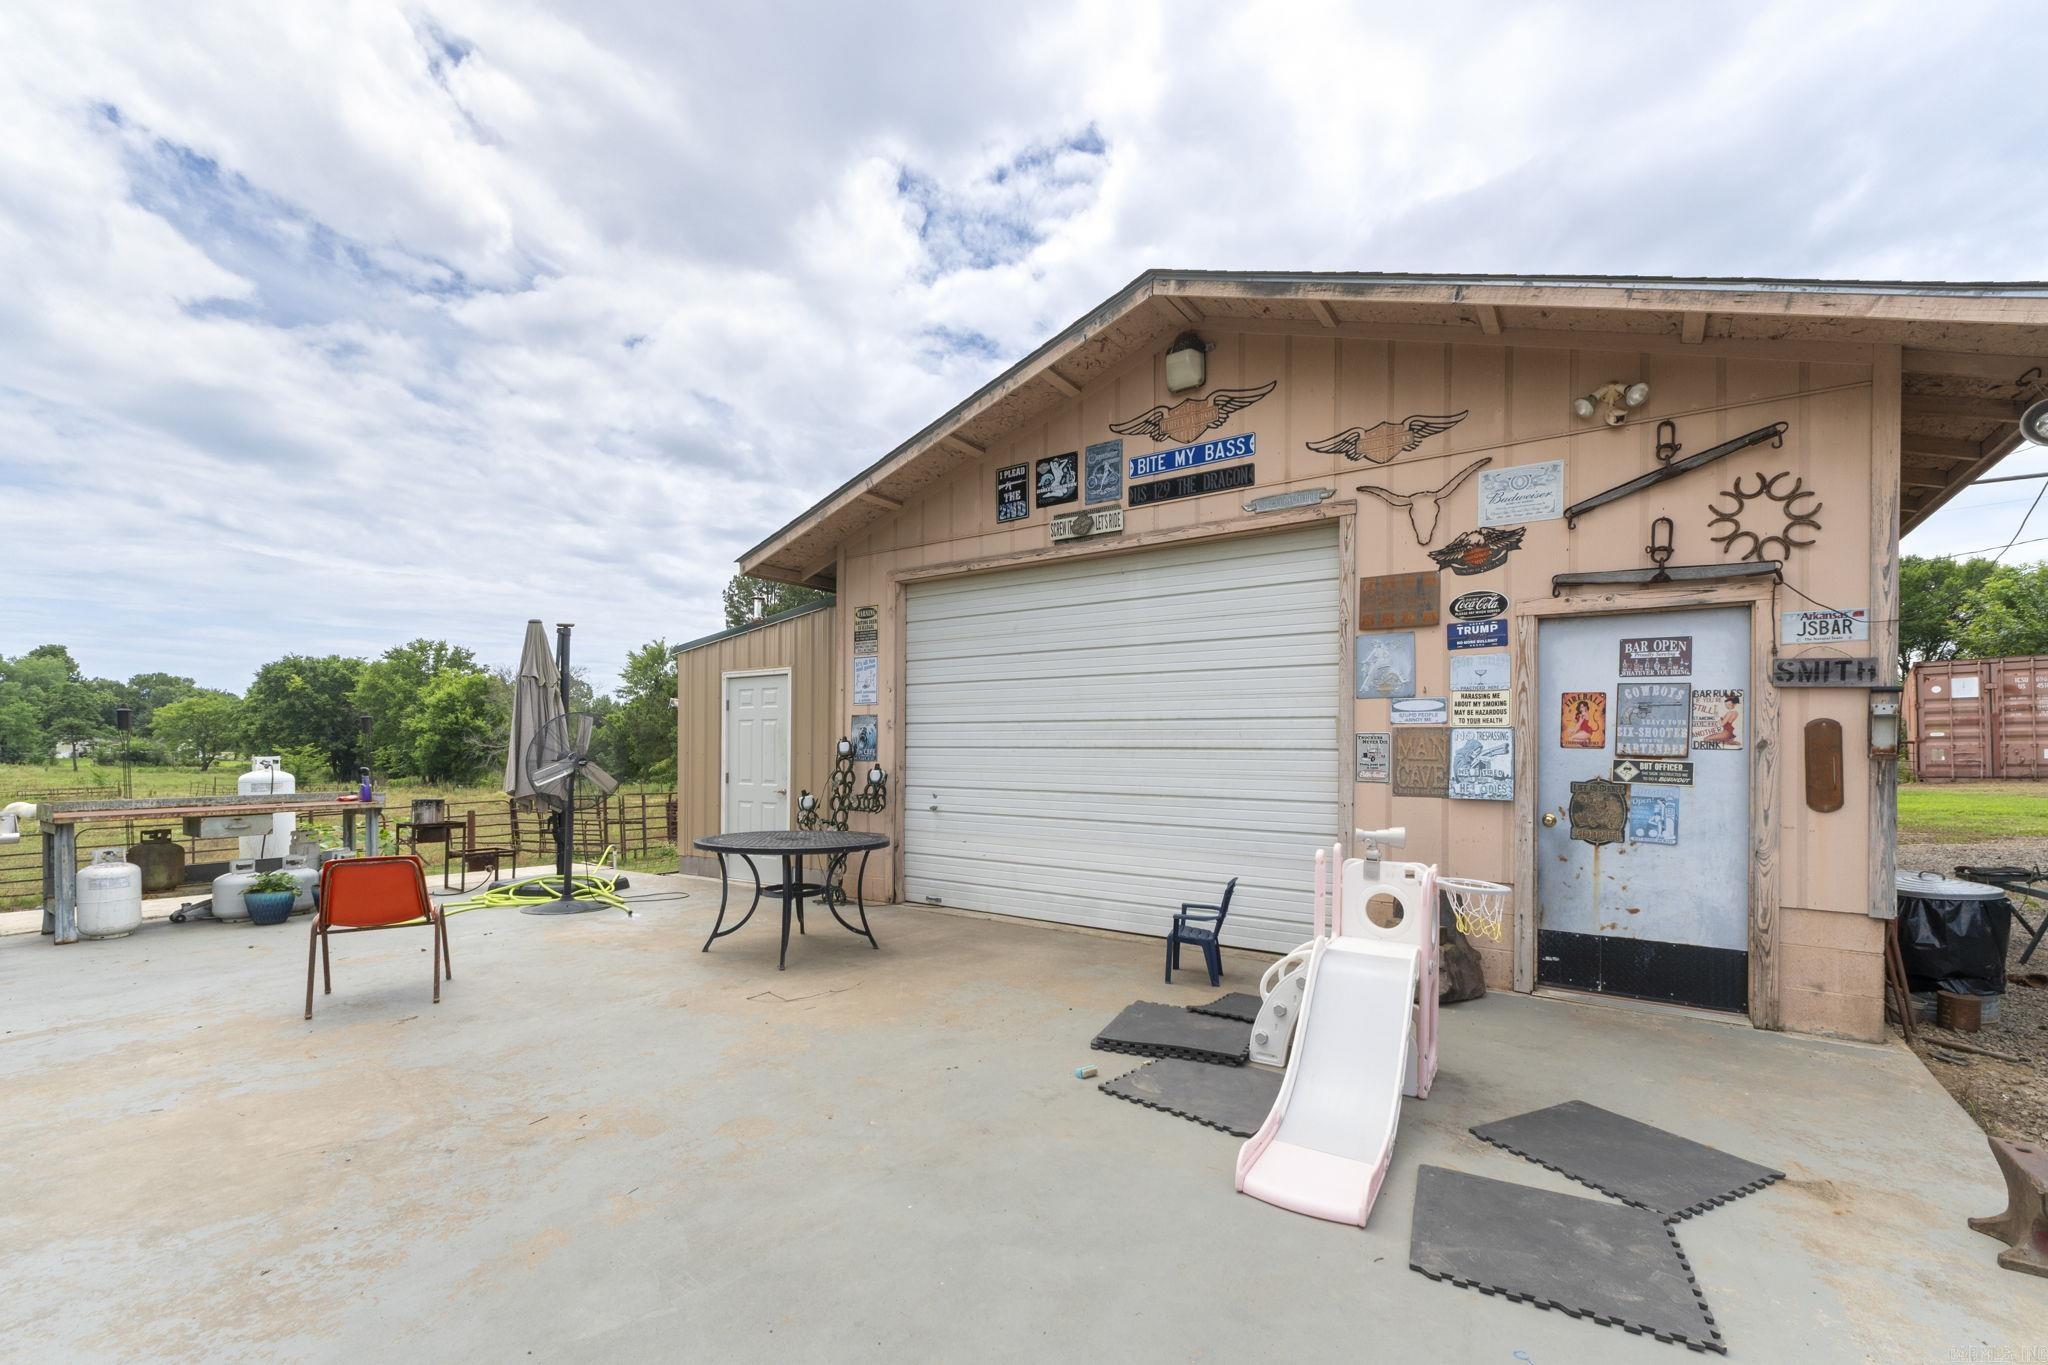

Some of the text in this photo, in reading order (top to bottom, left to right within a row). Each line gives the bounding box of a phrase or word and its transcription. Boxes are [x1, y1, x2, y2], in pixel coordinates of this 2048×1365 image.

[1138, 438, 1245, 474] BITE MY BASS
[1004, 467, 1026, 478] PLEAD
[1134, 466, 1249, 502] US 129 THE DRAGON
[1004, 490, 1021, 502] THE
[1489, 490, 1553, 505] Budweiser
[1051, 520, 1066, 537] SCREW
[1095, 513, 1109, 531] LET'S
[1109, 512, 1121, 529] RIDE
[1455, 595, 1501, 612] Coca-Cola
[1801, 612, 1849, 621] Arkansas
[1457, 624, 1498, 636] TRUMP
[1797, 619, 1853, 637] JSBAR
[1625, 640, 1687, 653] BAR OPEN
[1776, 660, 1877, 683] SMITH
[1625, 685, 1685, 700] COWBOYS
[1692, 689, 1743, 698] BAR RULES
[1565, 693, 1602, 707] FIREBALL
[1692, 704, 1714, 715] STILL
[1476, 731, 1509, 741] TRESPASSING
[1617, 727, 1688, 738] SIX-SHOOTER
[1692, 727, 1722, 738] ANOTHER
[1398, 736, 1446, 760] MAN
[1640, 762, 1653, 770] BUT
[1397, 764, 1445, 787] CAVE
